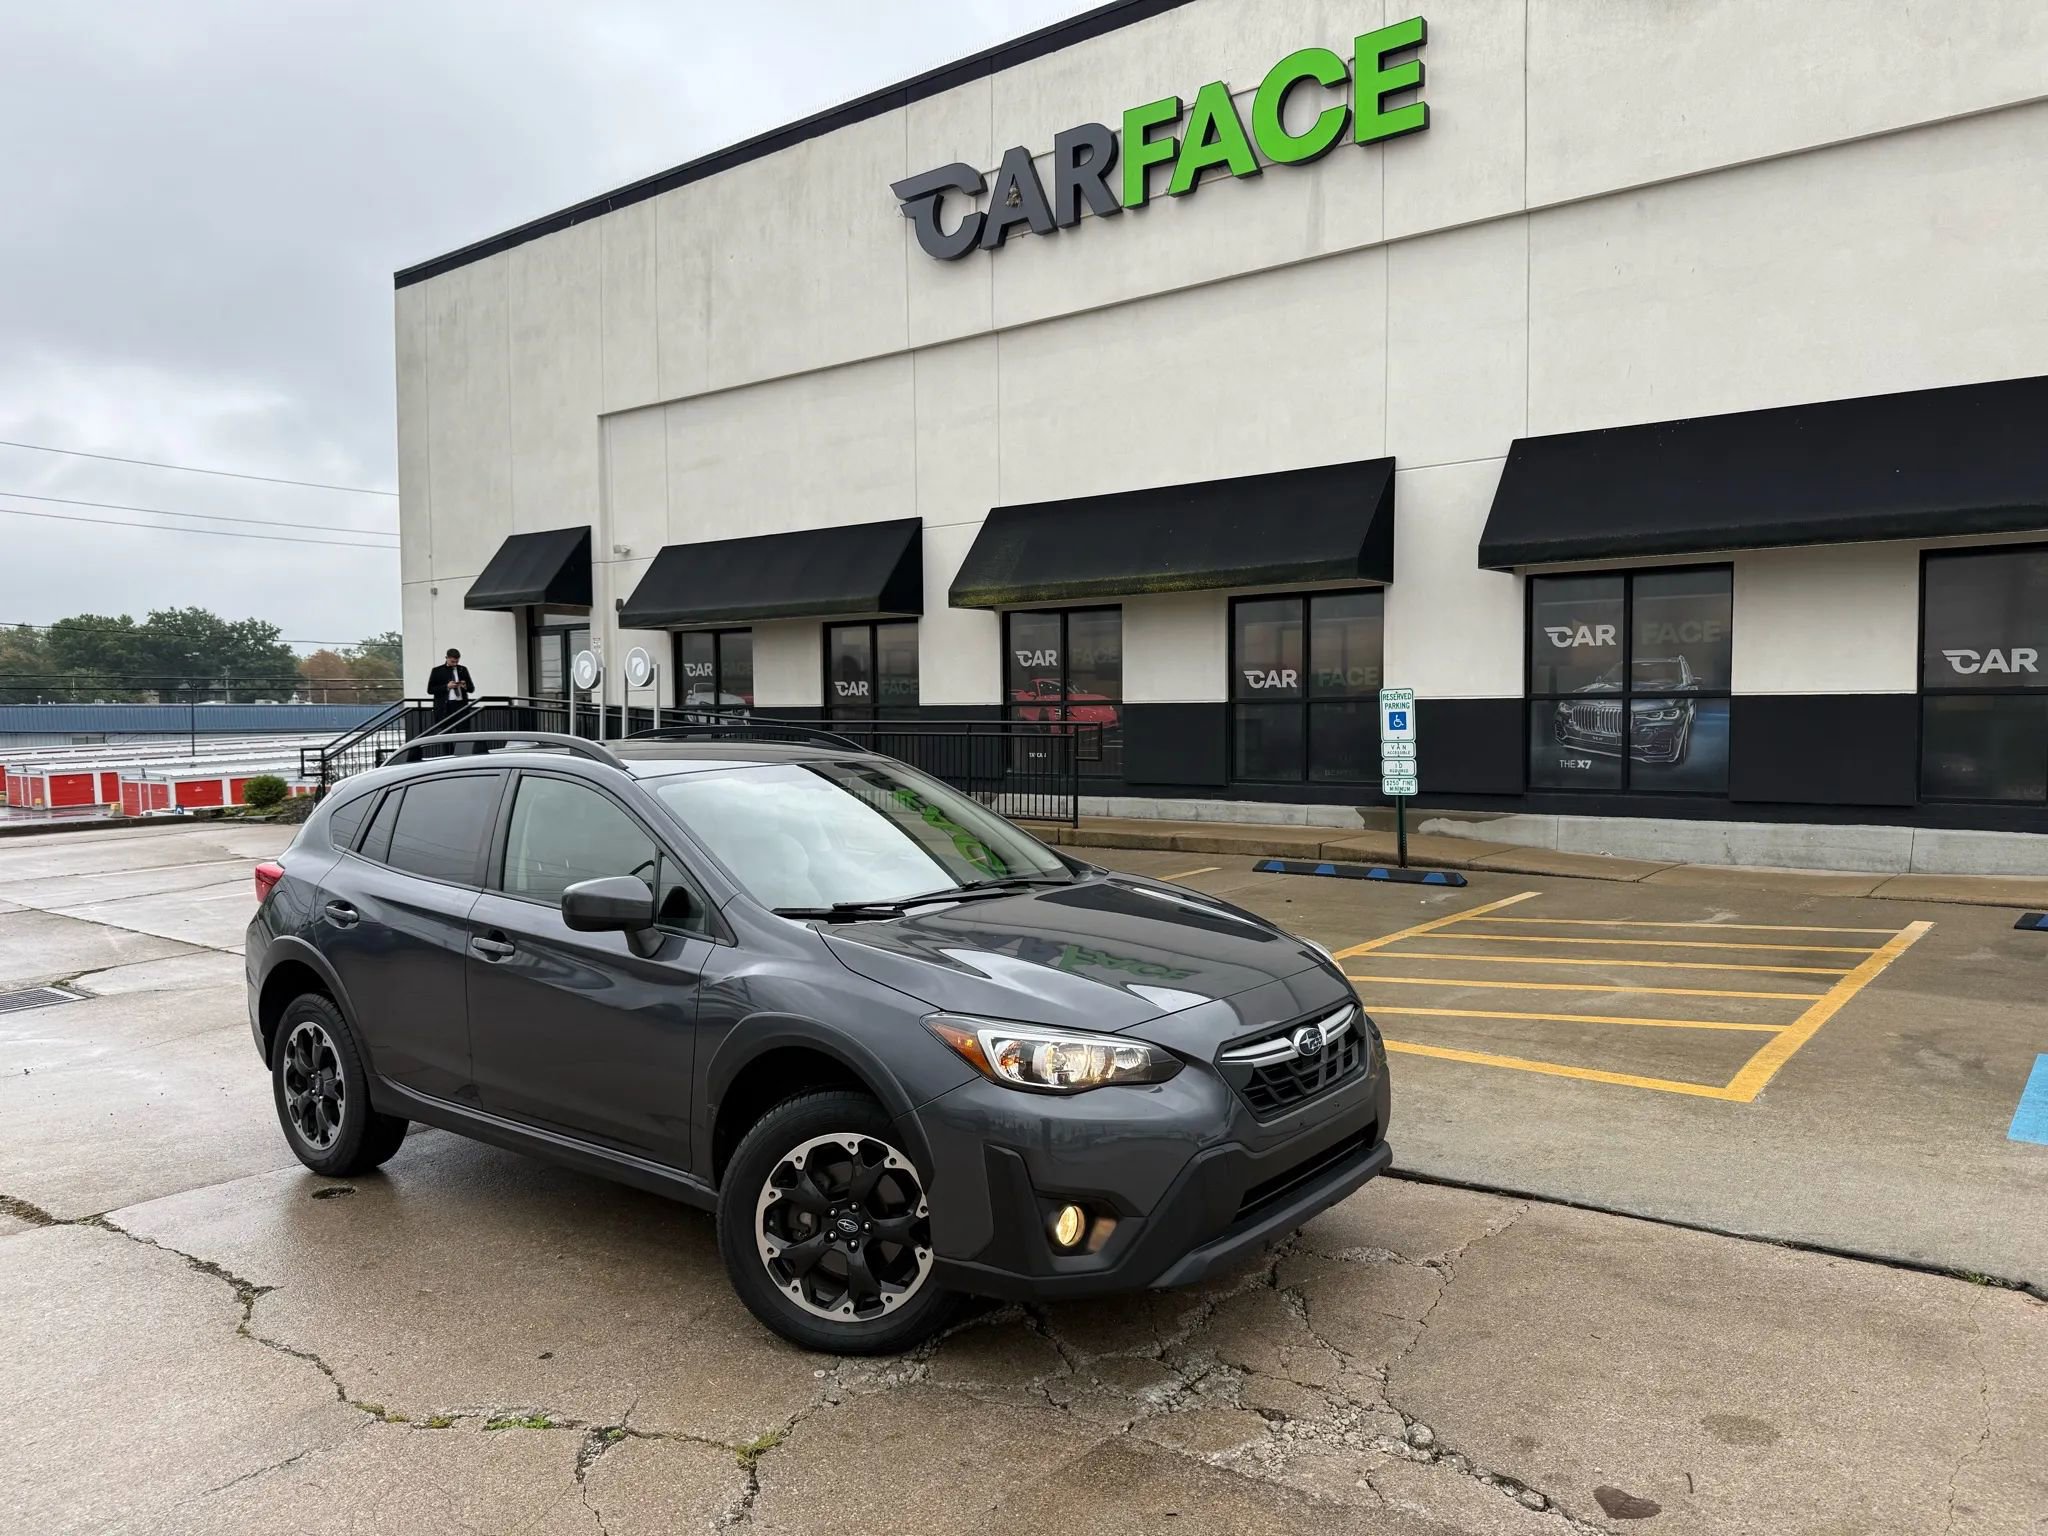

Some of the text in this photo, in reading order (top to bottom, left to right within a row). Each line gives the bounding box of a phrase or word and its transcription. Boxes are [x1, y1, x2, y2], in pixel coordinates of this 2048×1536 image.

[1543, 620, 1720, 648] CAR FACE
[1015, 649, 1058, 667] CAR
[1941, 647, 2040, 675] CAR
[684, 662, 713, 677] CAR
[1243, 669, 1298, 689] CAR
[834, 681, 869, 697] CAR
[1559, 759, 1592, 770] THE X7
